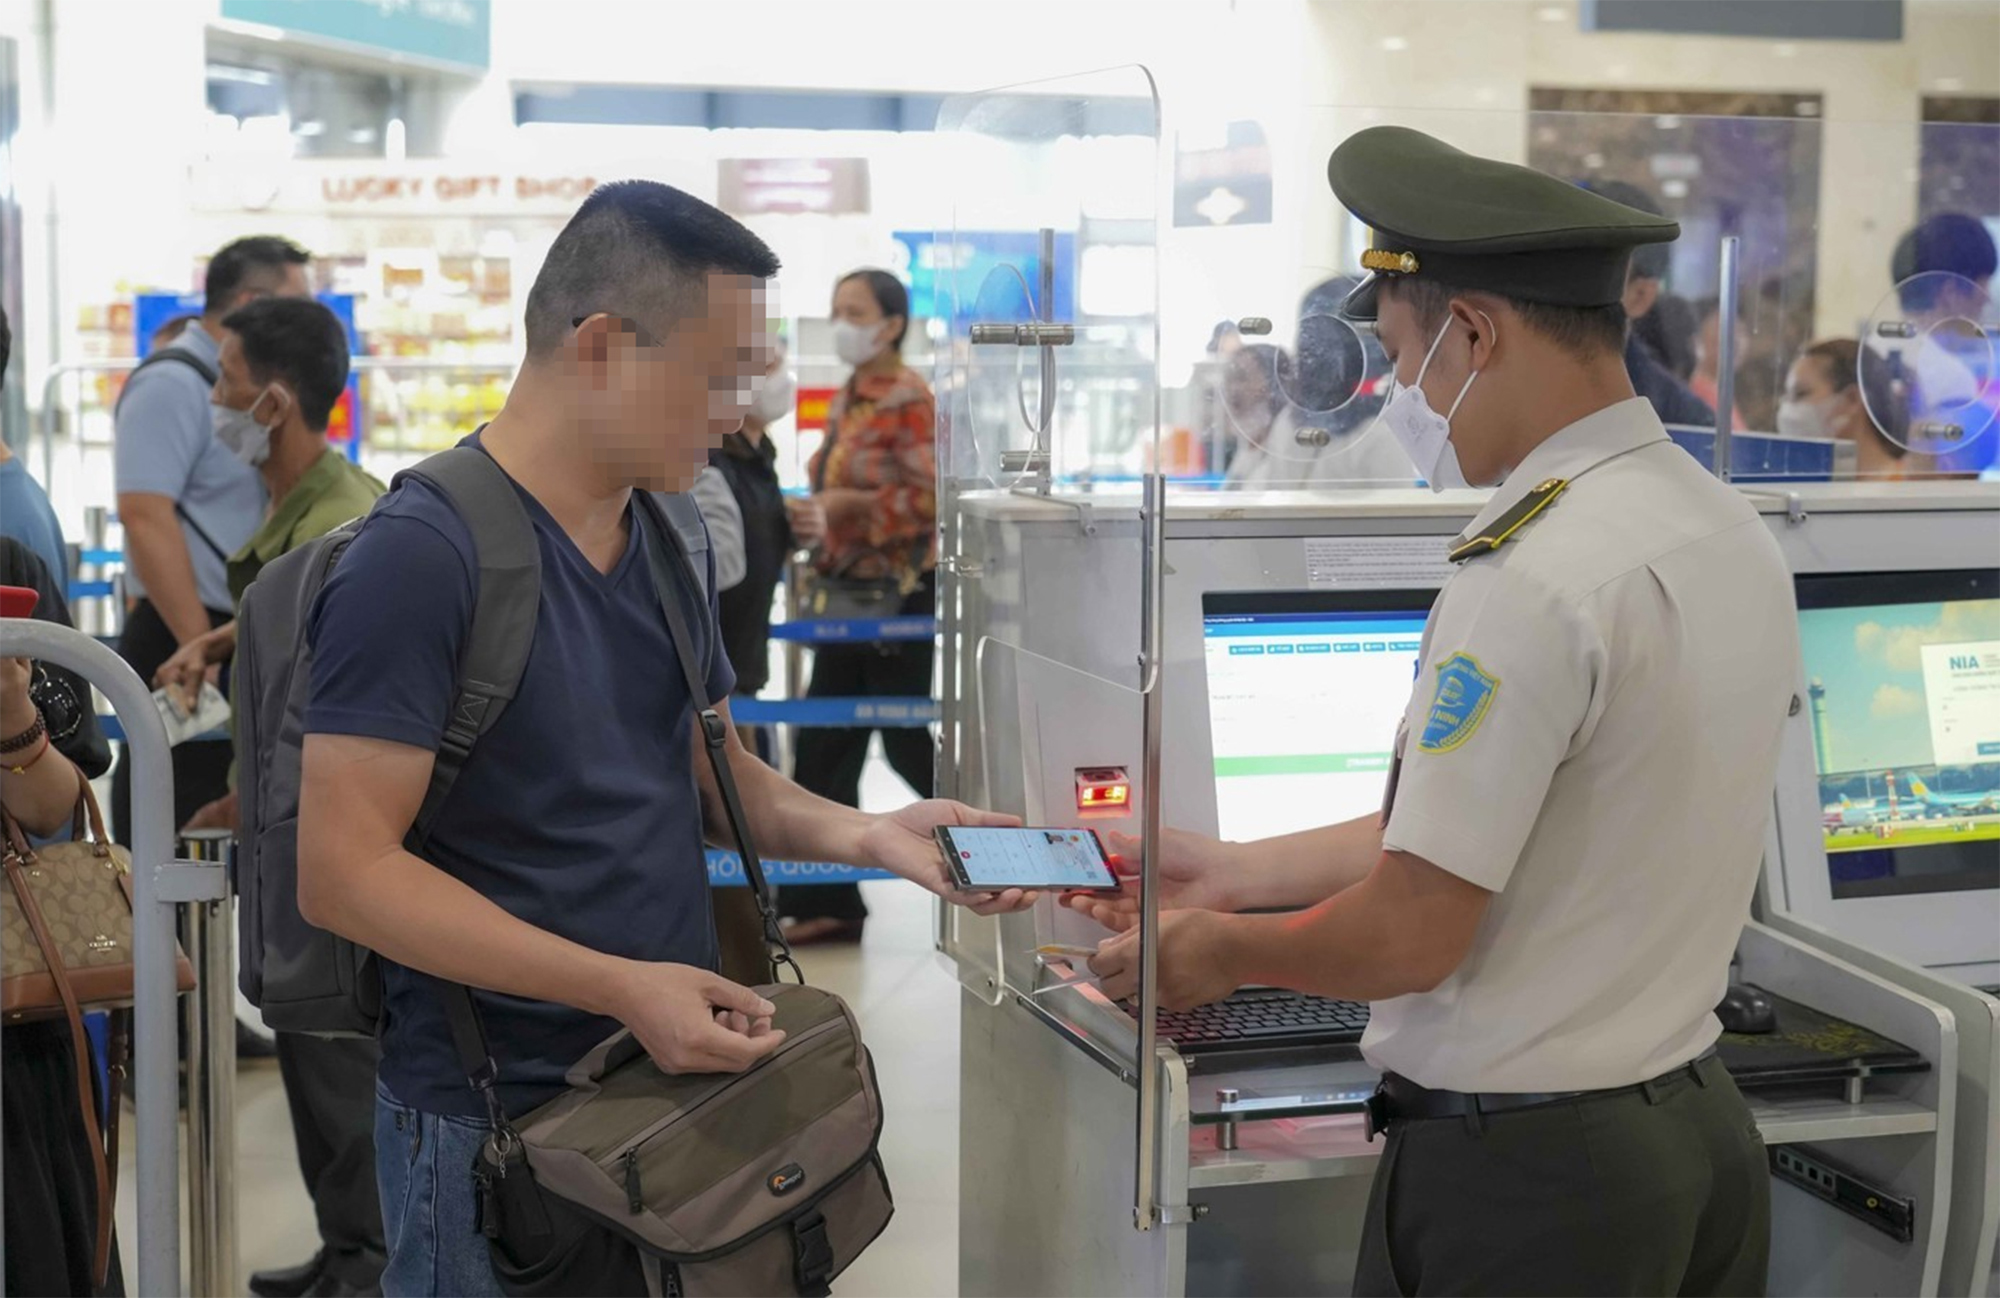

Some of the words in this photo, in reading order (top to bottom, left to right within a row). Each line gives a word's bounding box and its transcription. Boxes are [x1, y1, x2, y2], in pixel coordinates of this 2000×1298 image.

[322, 176, 422, 202] LUCKY
[434, 176, 500, 202] GIFT
[515, 176, 597, 201] SHOP
[1949, 655, 1980, 670] NIA
[1435, 709, 1460, 726] NINH
